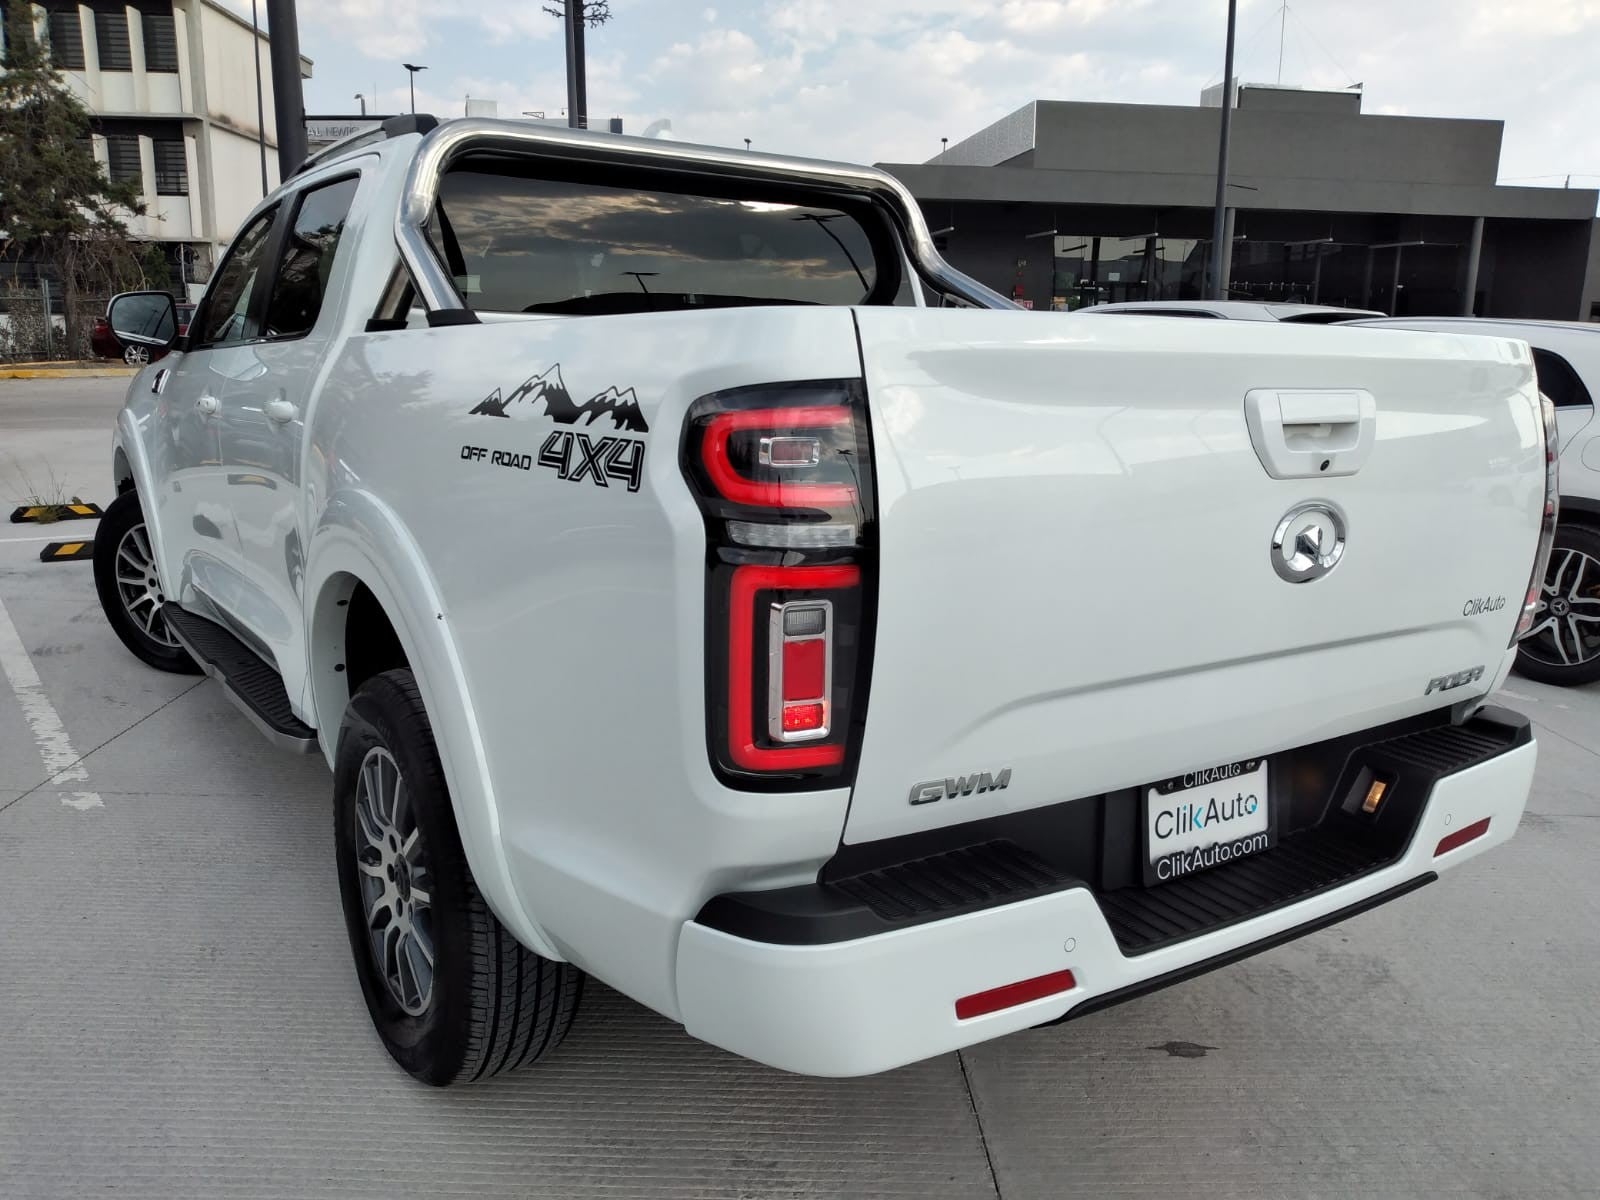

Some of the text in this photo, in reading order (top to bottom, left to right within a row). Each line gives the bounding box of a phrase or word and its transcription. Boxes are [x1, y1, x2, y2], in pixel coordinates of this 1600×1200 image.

[461, 430, 646, 493] OFF ROAD 4X4
[1463, 595, 1506, 616] ClikAuto
[909, 768, 1012, 806] GWM
[1183, 763, 1241, 788] ClikAuto
[1154, 793, 1258, 839] ClikAuto
[1157, 834, 1268, 880] ClikAuto.com
